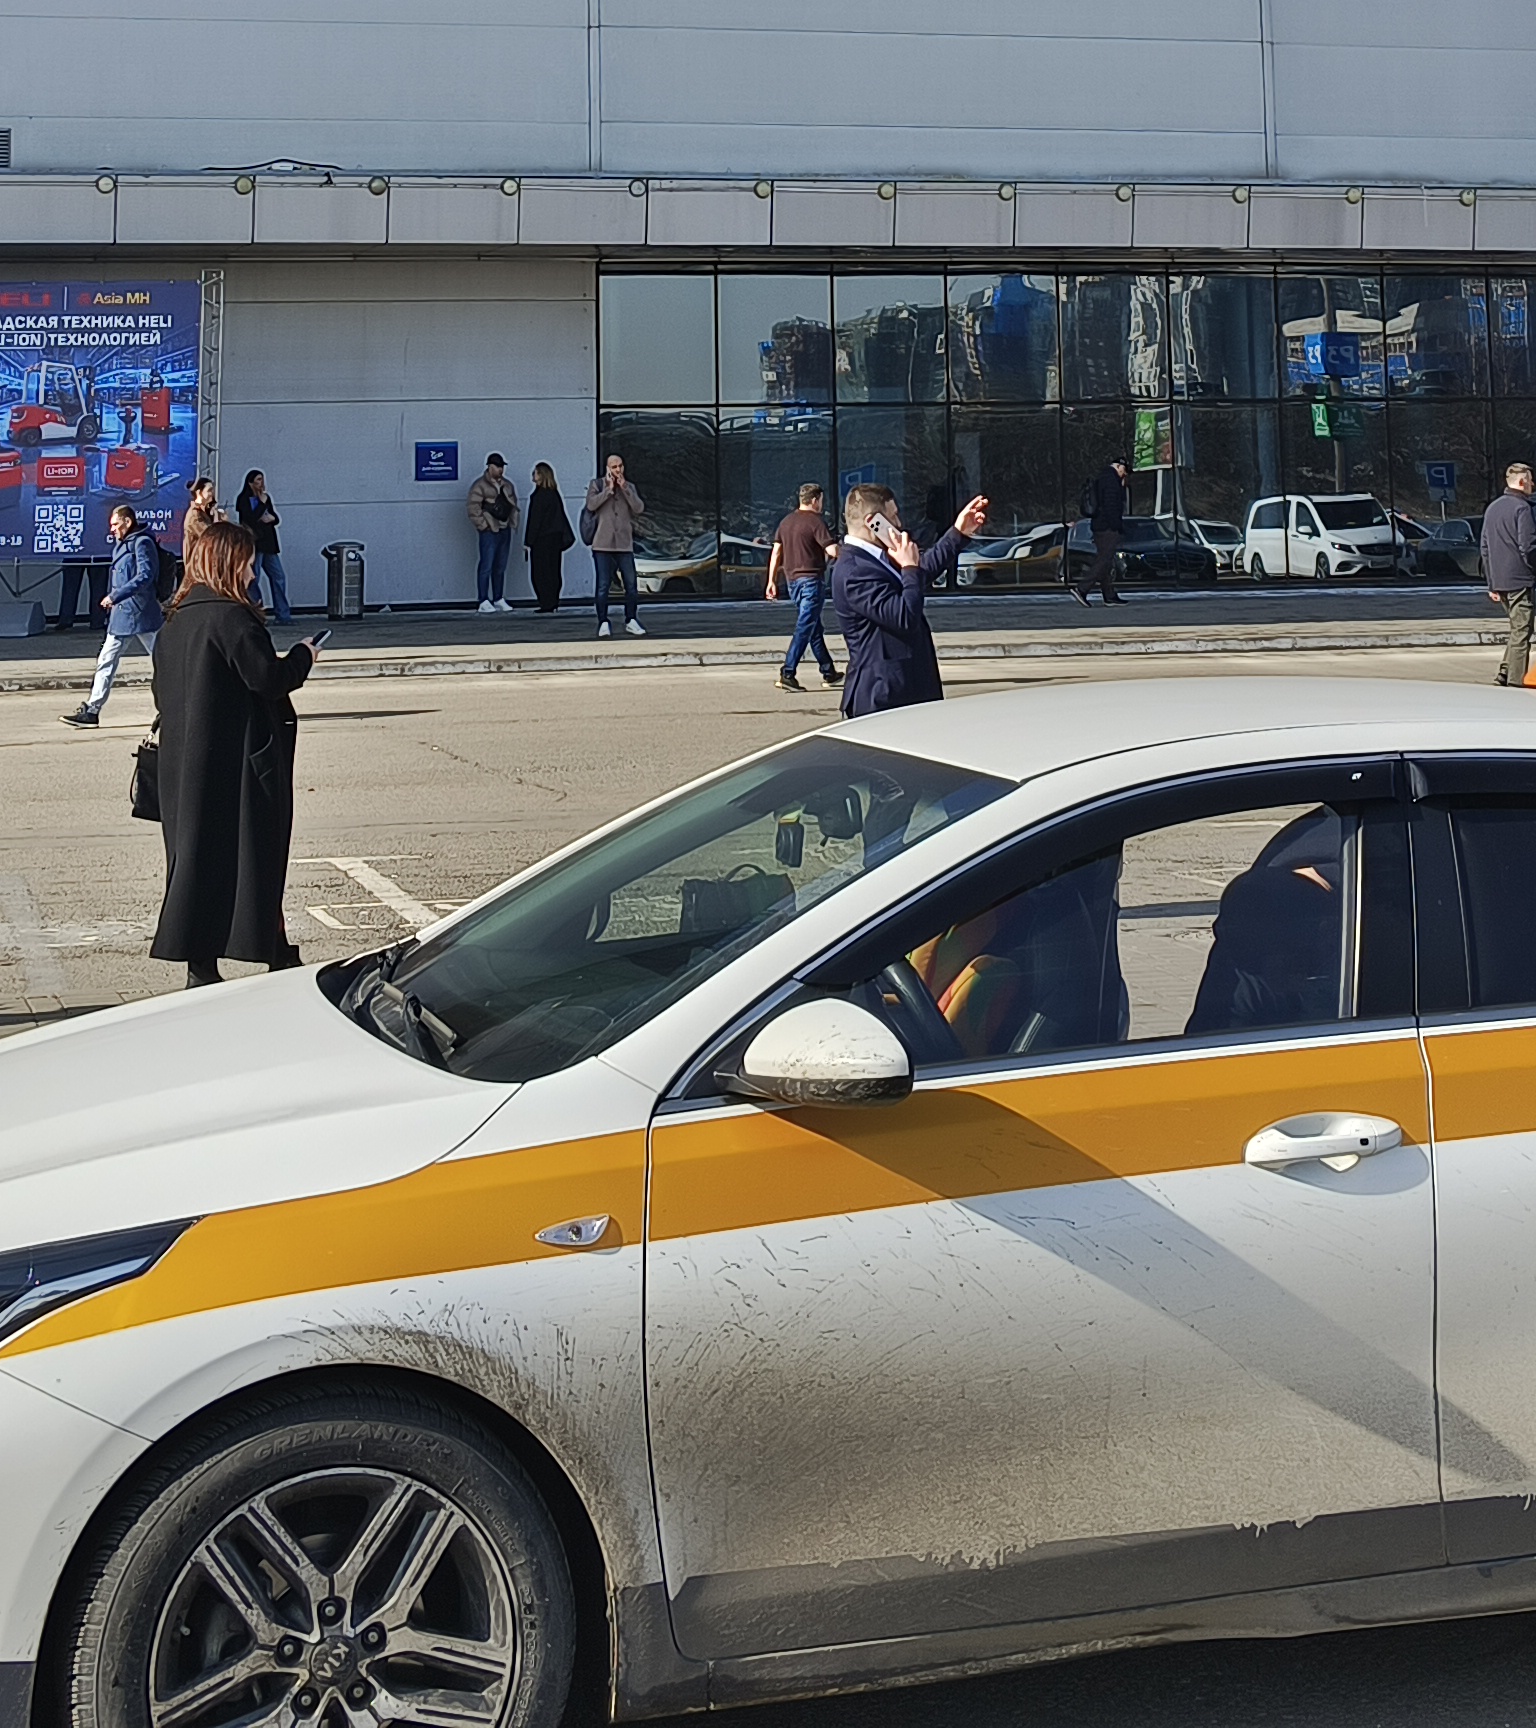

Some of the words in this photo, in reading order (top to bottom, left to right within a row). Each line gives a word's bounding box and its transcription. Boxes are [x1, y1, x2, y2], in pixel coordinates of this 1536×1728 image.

[93, 292, 124, 305] Asia
[126, 292, 150, 305] MH
[61, 315, 135, 329] ТЕХНИКА
[138, 315, 172, 328] HELI
[47, 329, 161, 346] ТЕХНОЛОГИЕЙ
[135, 509, 172, 519] ИЛЬОН
[317, 1642, 349, 1678] KIA
